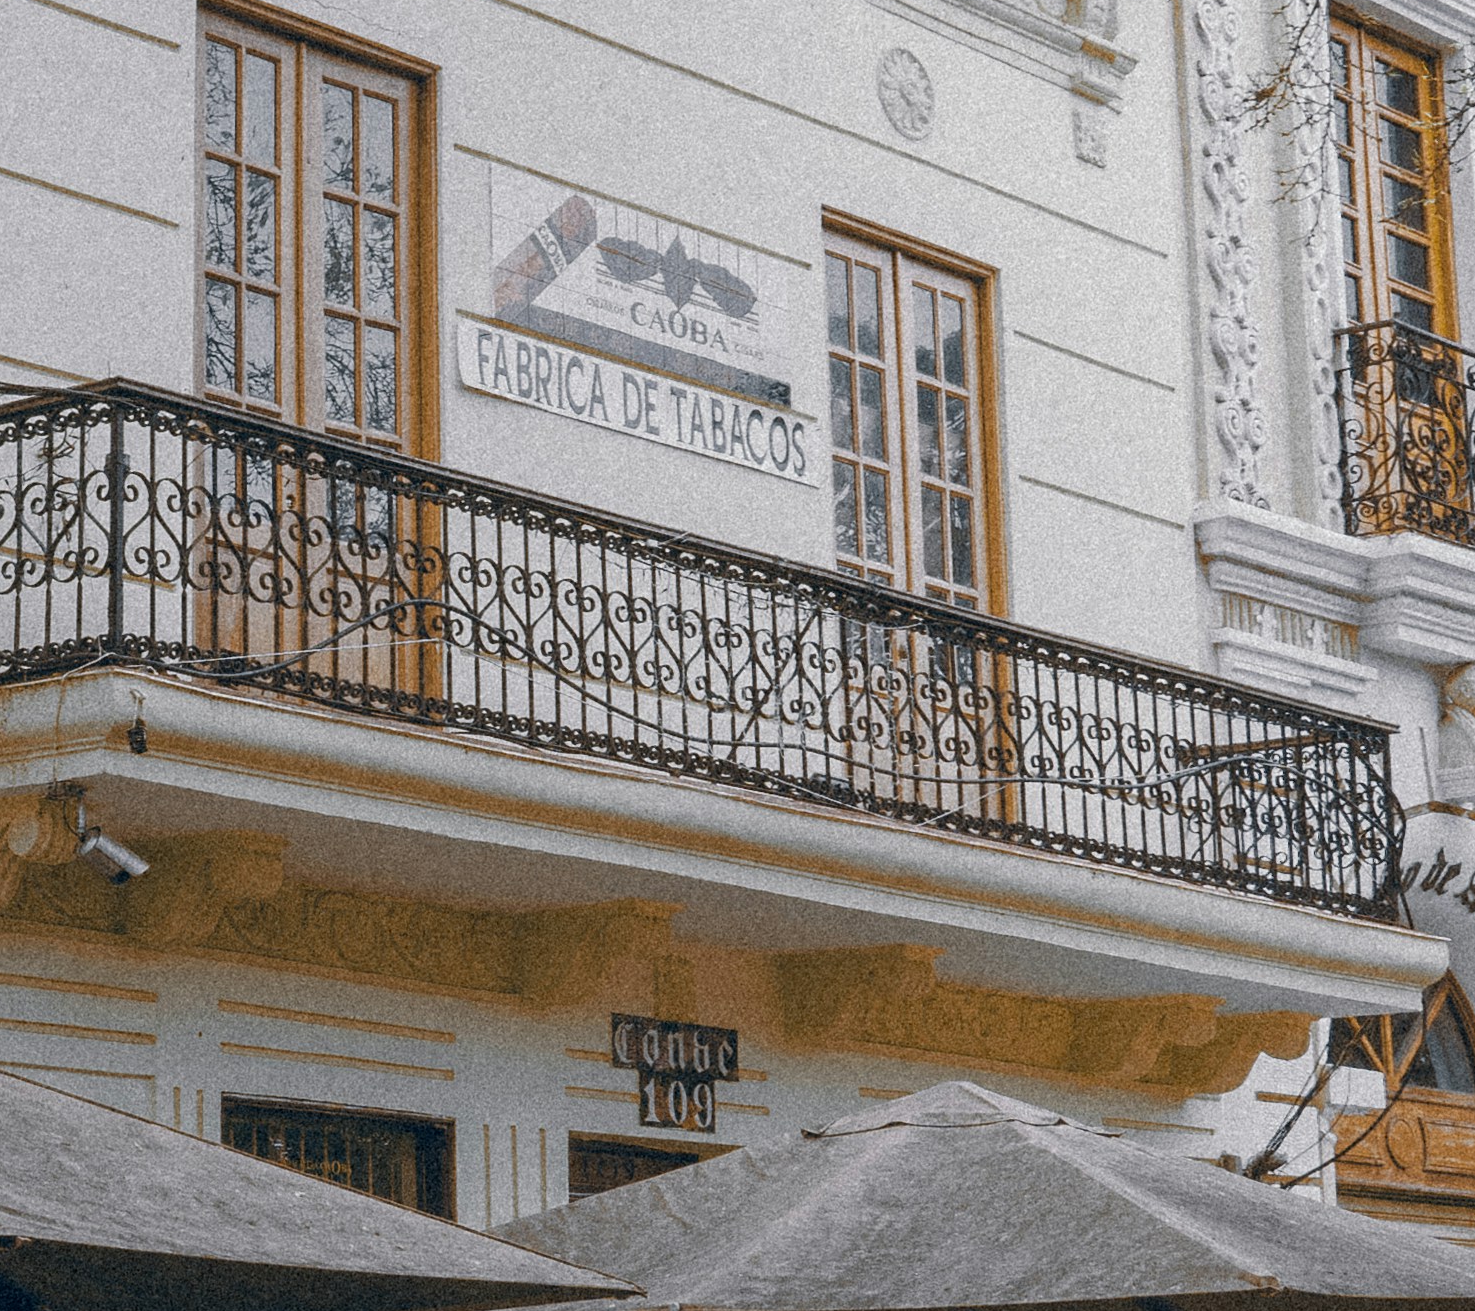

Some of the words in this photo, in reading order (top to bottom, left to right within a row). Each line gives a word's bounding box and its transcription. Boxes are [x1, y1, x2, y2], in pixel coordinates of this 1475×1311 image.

[630, 301, 730, 353] CAOBA
[477, 327, 611, 423] FABRICA
[622, 371, 661, 436] DE
[670, 389, 808, 478] TABACOS
[613, 1020, 734, 1078] Conde
[642, 1077, 714, 1129] 109
